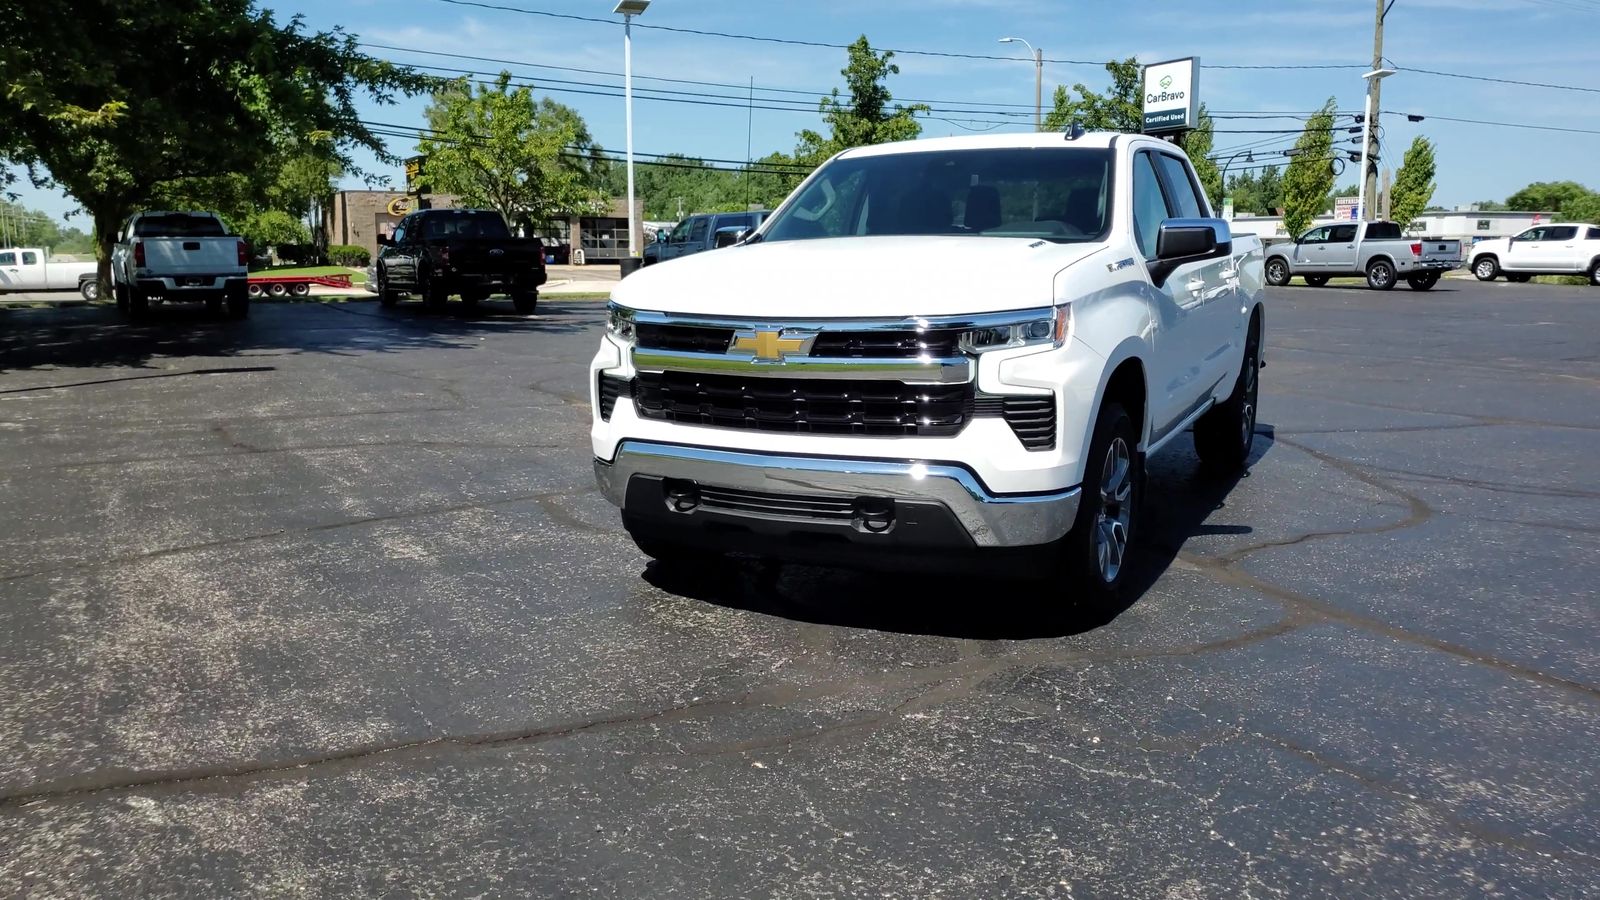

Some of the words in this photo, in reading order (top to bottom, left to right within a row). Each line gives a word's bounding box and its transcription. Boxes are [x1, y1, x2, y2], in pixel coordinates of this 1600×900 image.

[1146, 91, 1185, 104] CarBravo
[1145, 115, 1170, 123] Certified
[1170, 113, 1185, 121] Used
